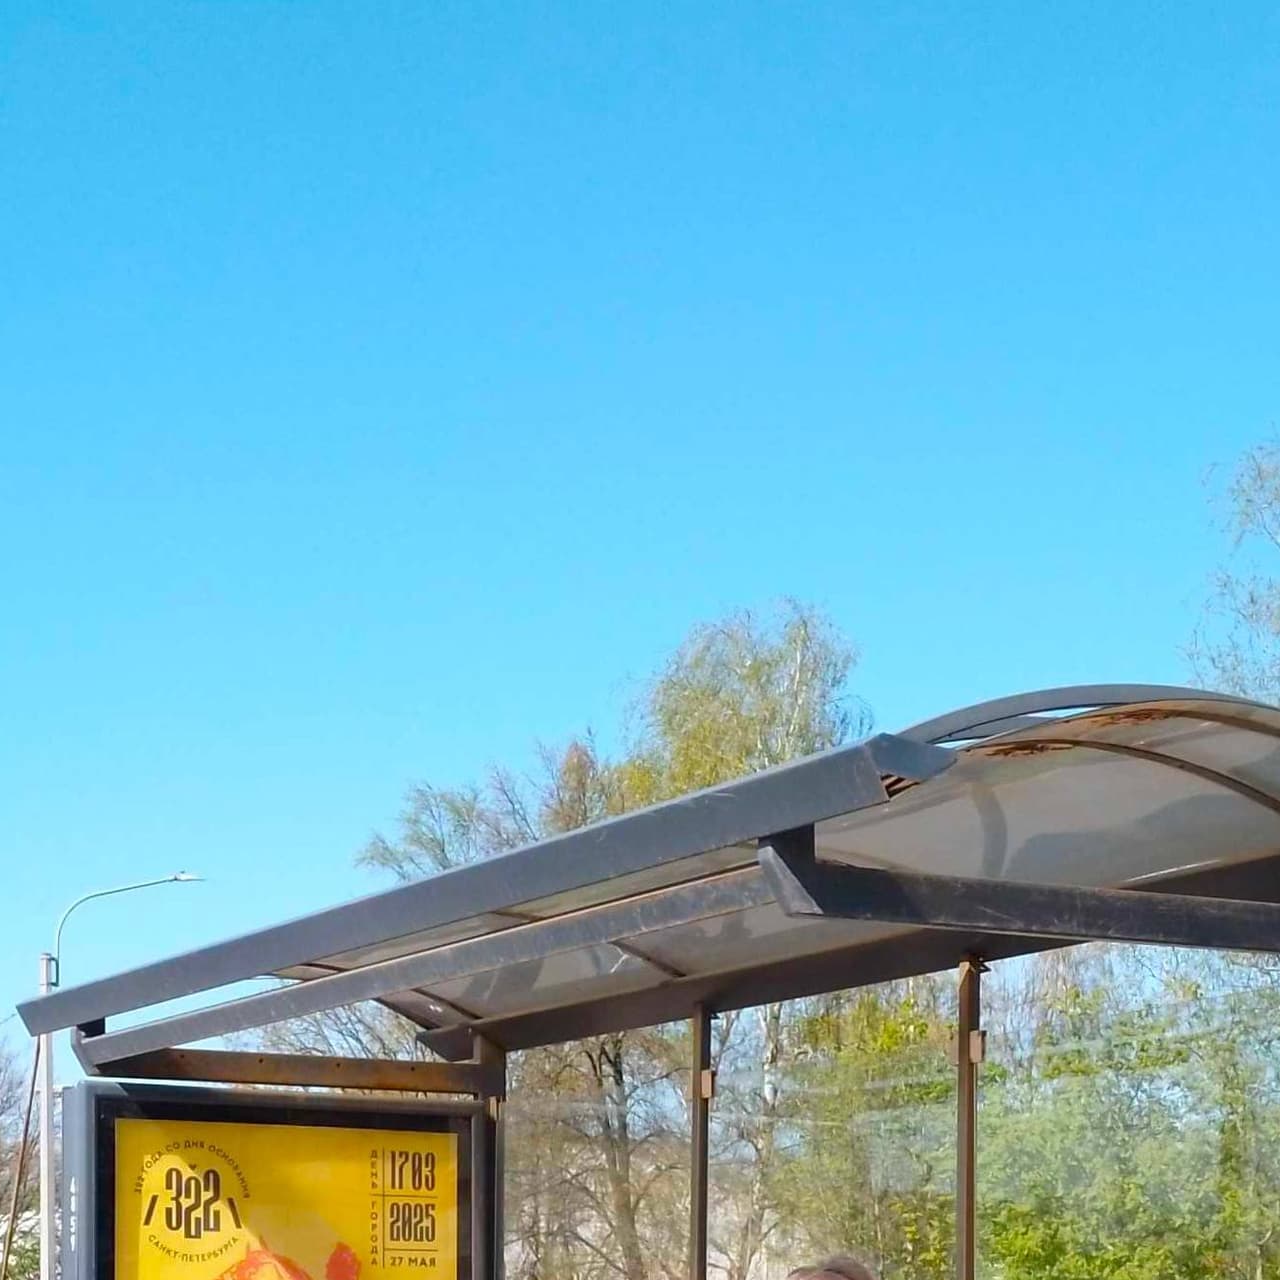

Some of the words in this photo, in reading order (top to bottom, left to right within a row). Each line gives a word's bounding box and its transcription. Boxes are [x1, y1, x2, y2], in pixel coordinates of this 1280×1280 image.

[165, 1141, 180, 1152] СО
[183, 1140, 205, 1149] ДНЯ
[370, 1149, 378, 1189] ДЕНЬ
[390, 1150, 436, 1191] 1703
[165, 1167, 221, 1239] 322
[390, 1202, 436, 1242] 2025
[148, 1234, 239, 1262] САНКТ-ПЕТЕРБУРГА
[370, 1201, 378, 1265] ГОРОДА
[390, 1256, 403, 1266] 27
[408, 1257, 436, 1268] МАЯ
